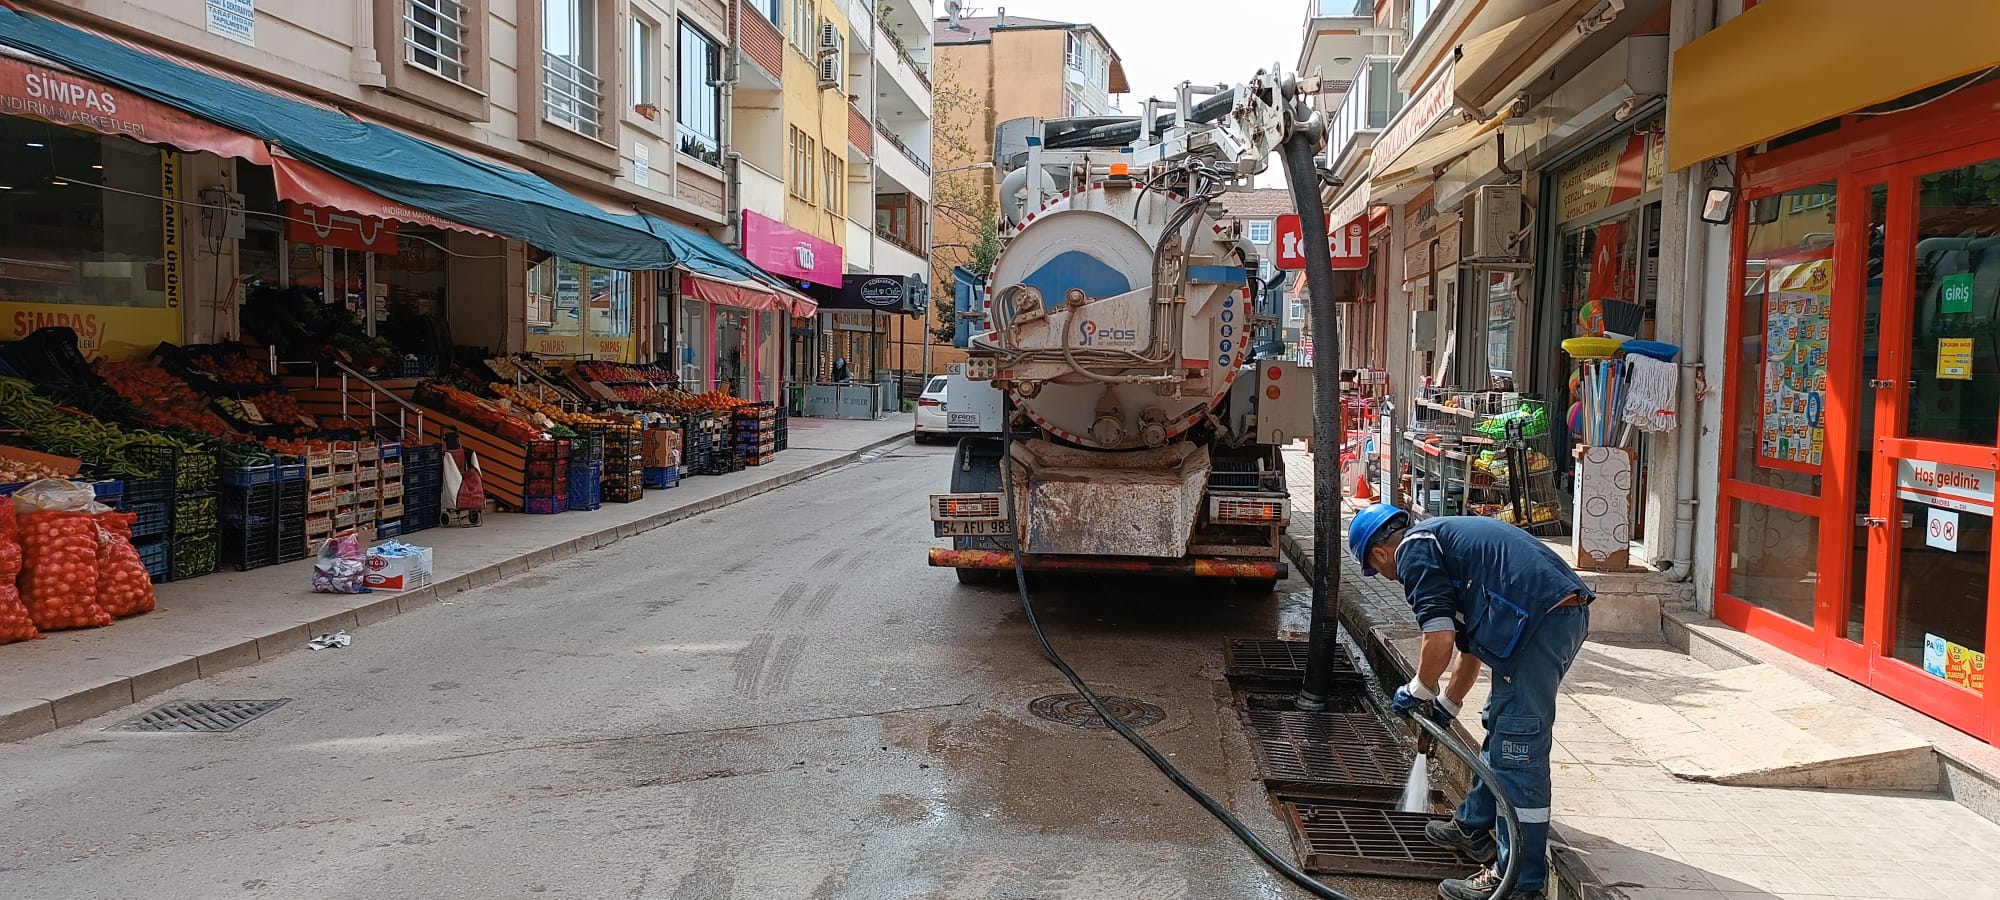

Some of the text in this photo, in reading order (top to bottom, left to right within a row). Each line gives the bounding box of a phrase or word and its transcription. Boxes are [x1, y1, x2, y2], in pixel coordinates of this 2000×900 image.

[26, 72, 117, 115] SİMPAŞ
[0, 95, 55, 116] NDİRİM
[166, 251, 179, 309] ÜRÜNÜ
[1945, 284, 1969, 303] GİRİŞ
[1915, 467, 1979, 491] Hoş geldiniz
[943, 521, 1011, 534] 54 AFU 983
